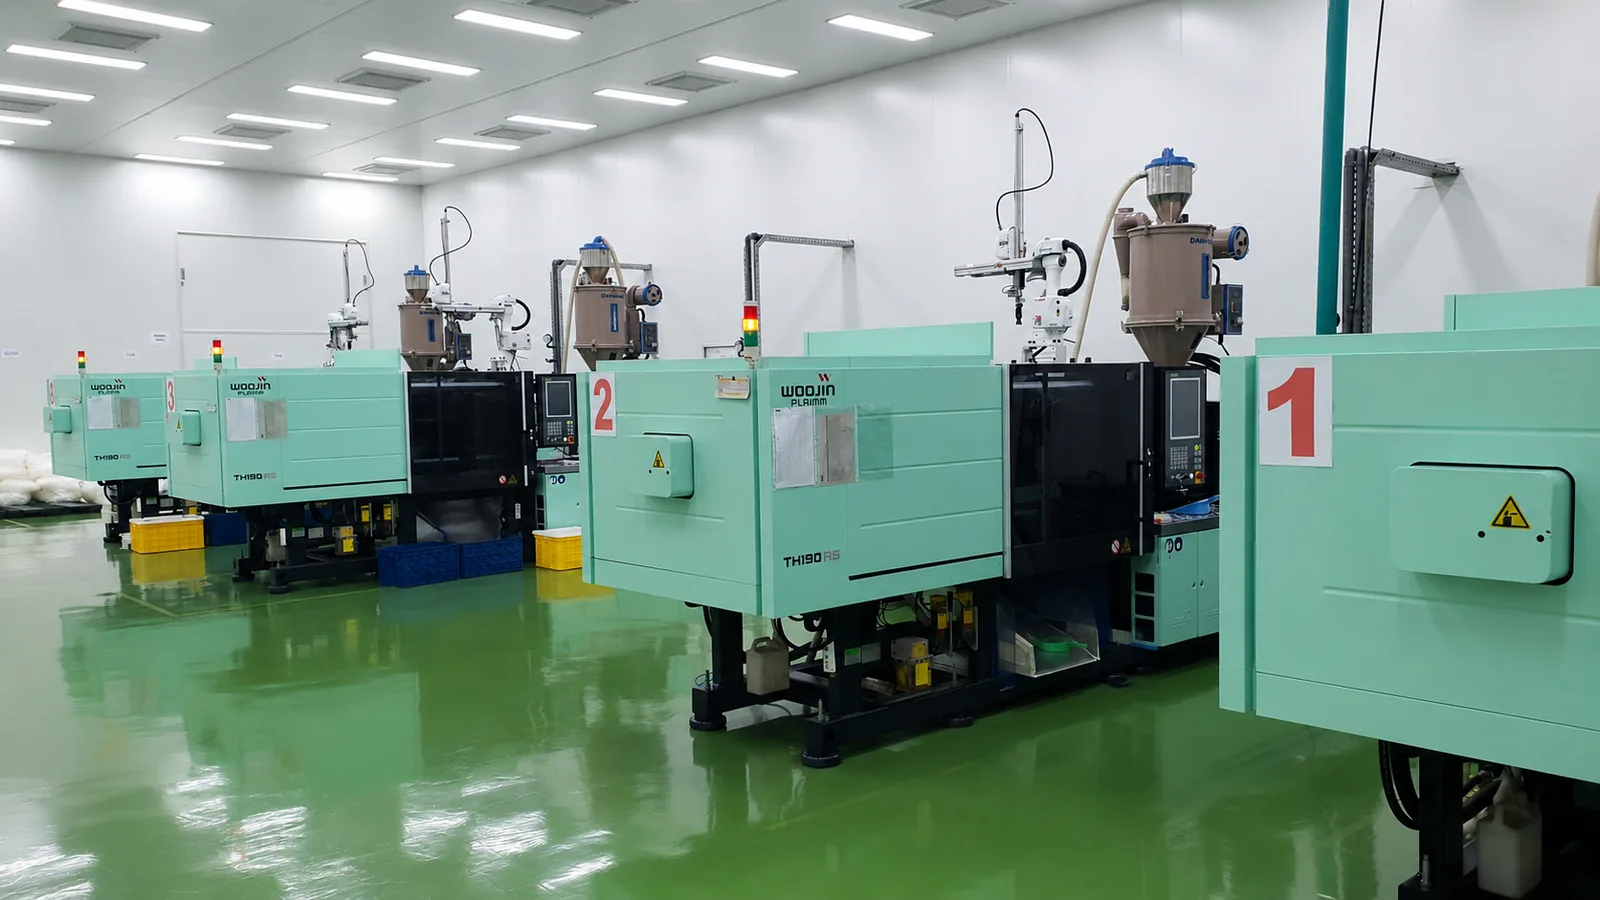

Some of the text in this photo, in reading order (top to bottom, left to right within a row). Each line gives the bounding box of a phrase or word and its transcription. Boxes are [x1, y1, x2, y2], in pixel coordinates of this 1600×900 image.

[230, 382, 271, 391] WOOJIN
[781, 384, 836, 398] WOOJIN
[168, 381, 175, 411] 3
[593, 378, 613, 431] 2
[1267, 367, 1316, 458] 1
[233, 473, 263, 481] TH190
[783, 552, 822, 568] TH190
